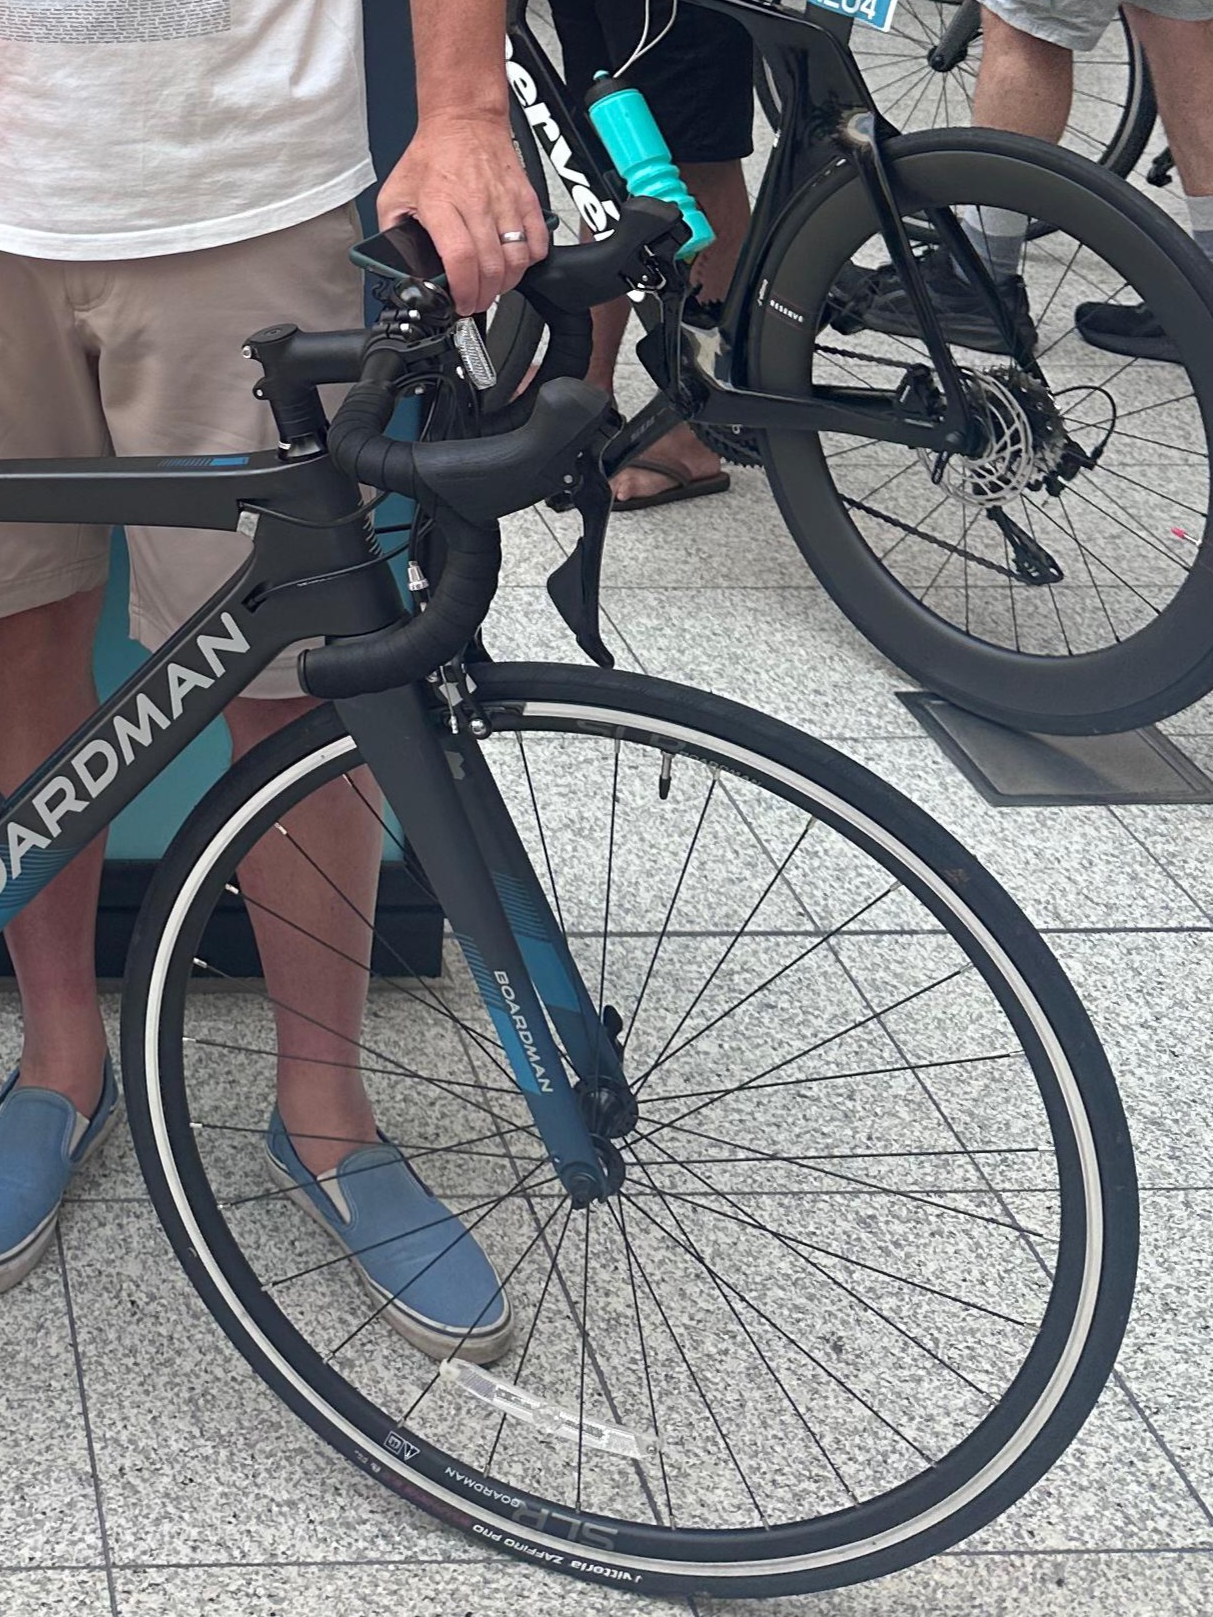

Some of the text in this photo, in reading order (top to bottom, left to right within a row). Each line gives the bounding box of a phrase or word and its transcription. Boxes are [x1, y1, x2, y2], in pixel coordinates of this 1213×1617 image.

[506, 33, 621, 242] ervé
[493, 969, 554, 1094] BOARDMAN
[444, 1465, 521, 1509] BOARDMAN
[472, 1523, 633, 1583] vittoria ZAFFIRO PRO
